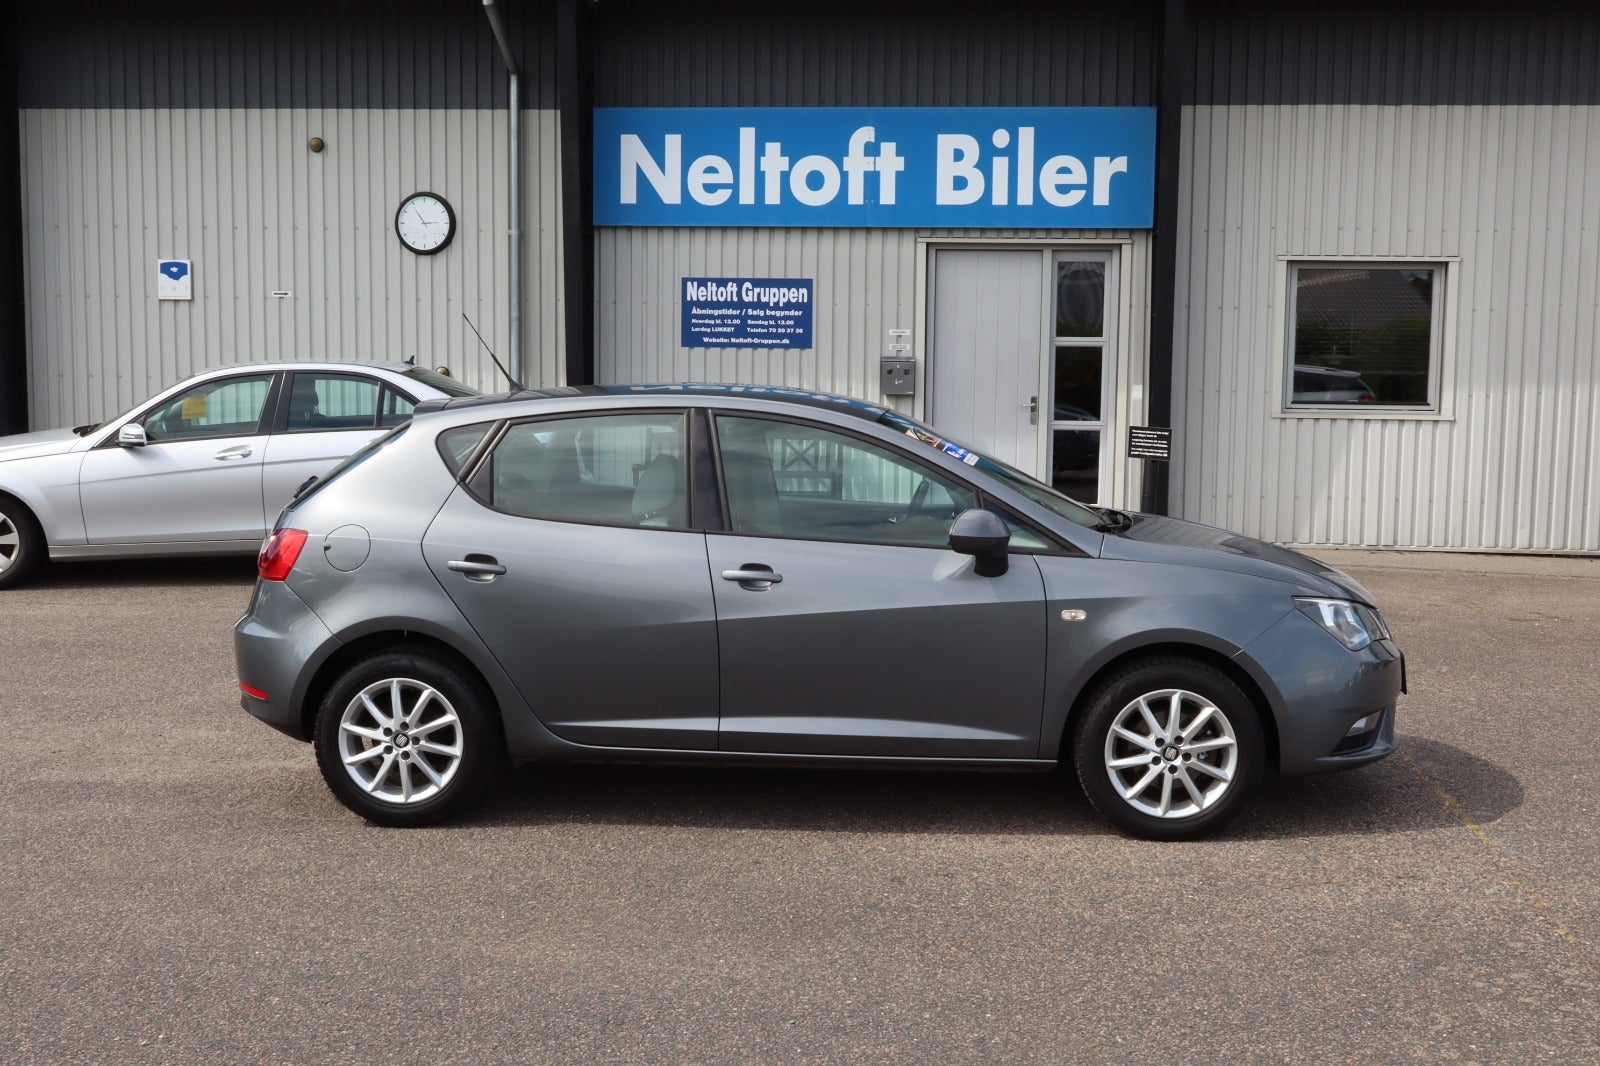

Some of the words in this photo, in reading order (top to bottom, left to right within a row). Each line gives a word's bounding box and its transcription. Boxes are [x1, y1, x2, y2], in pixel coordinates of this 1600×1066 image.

[619, 126, 905, 207] Neltoft
[936, 127, 1128, 208] Biler
[687, 281, 738, 302] Neltoft
[742, 282, 808, 306] Gruppen
[691, 306, 741, 316] Åbningstider
[766, 309, 803, 317] begynder
